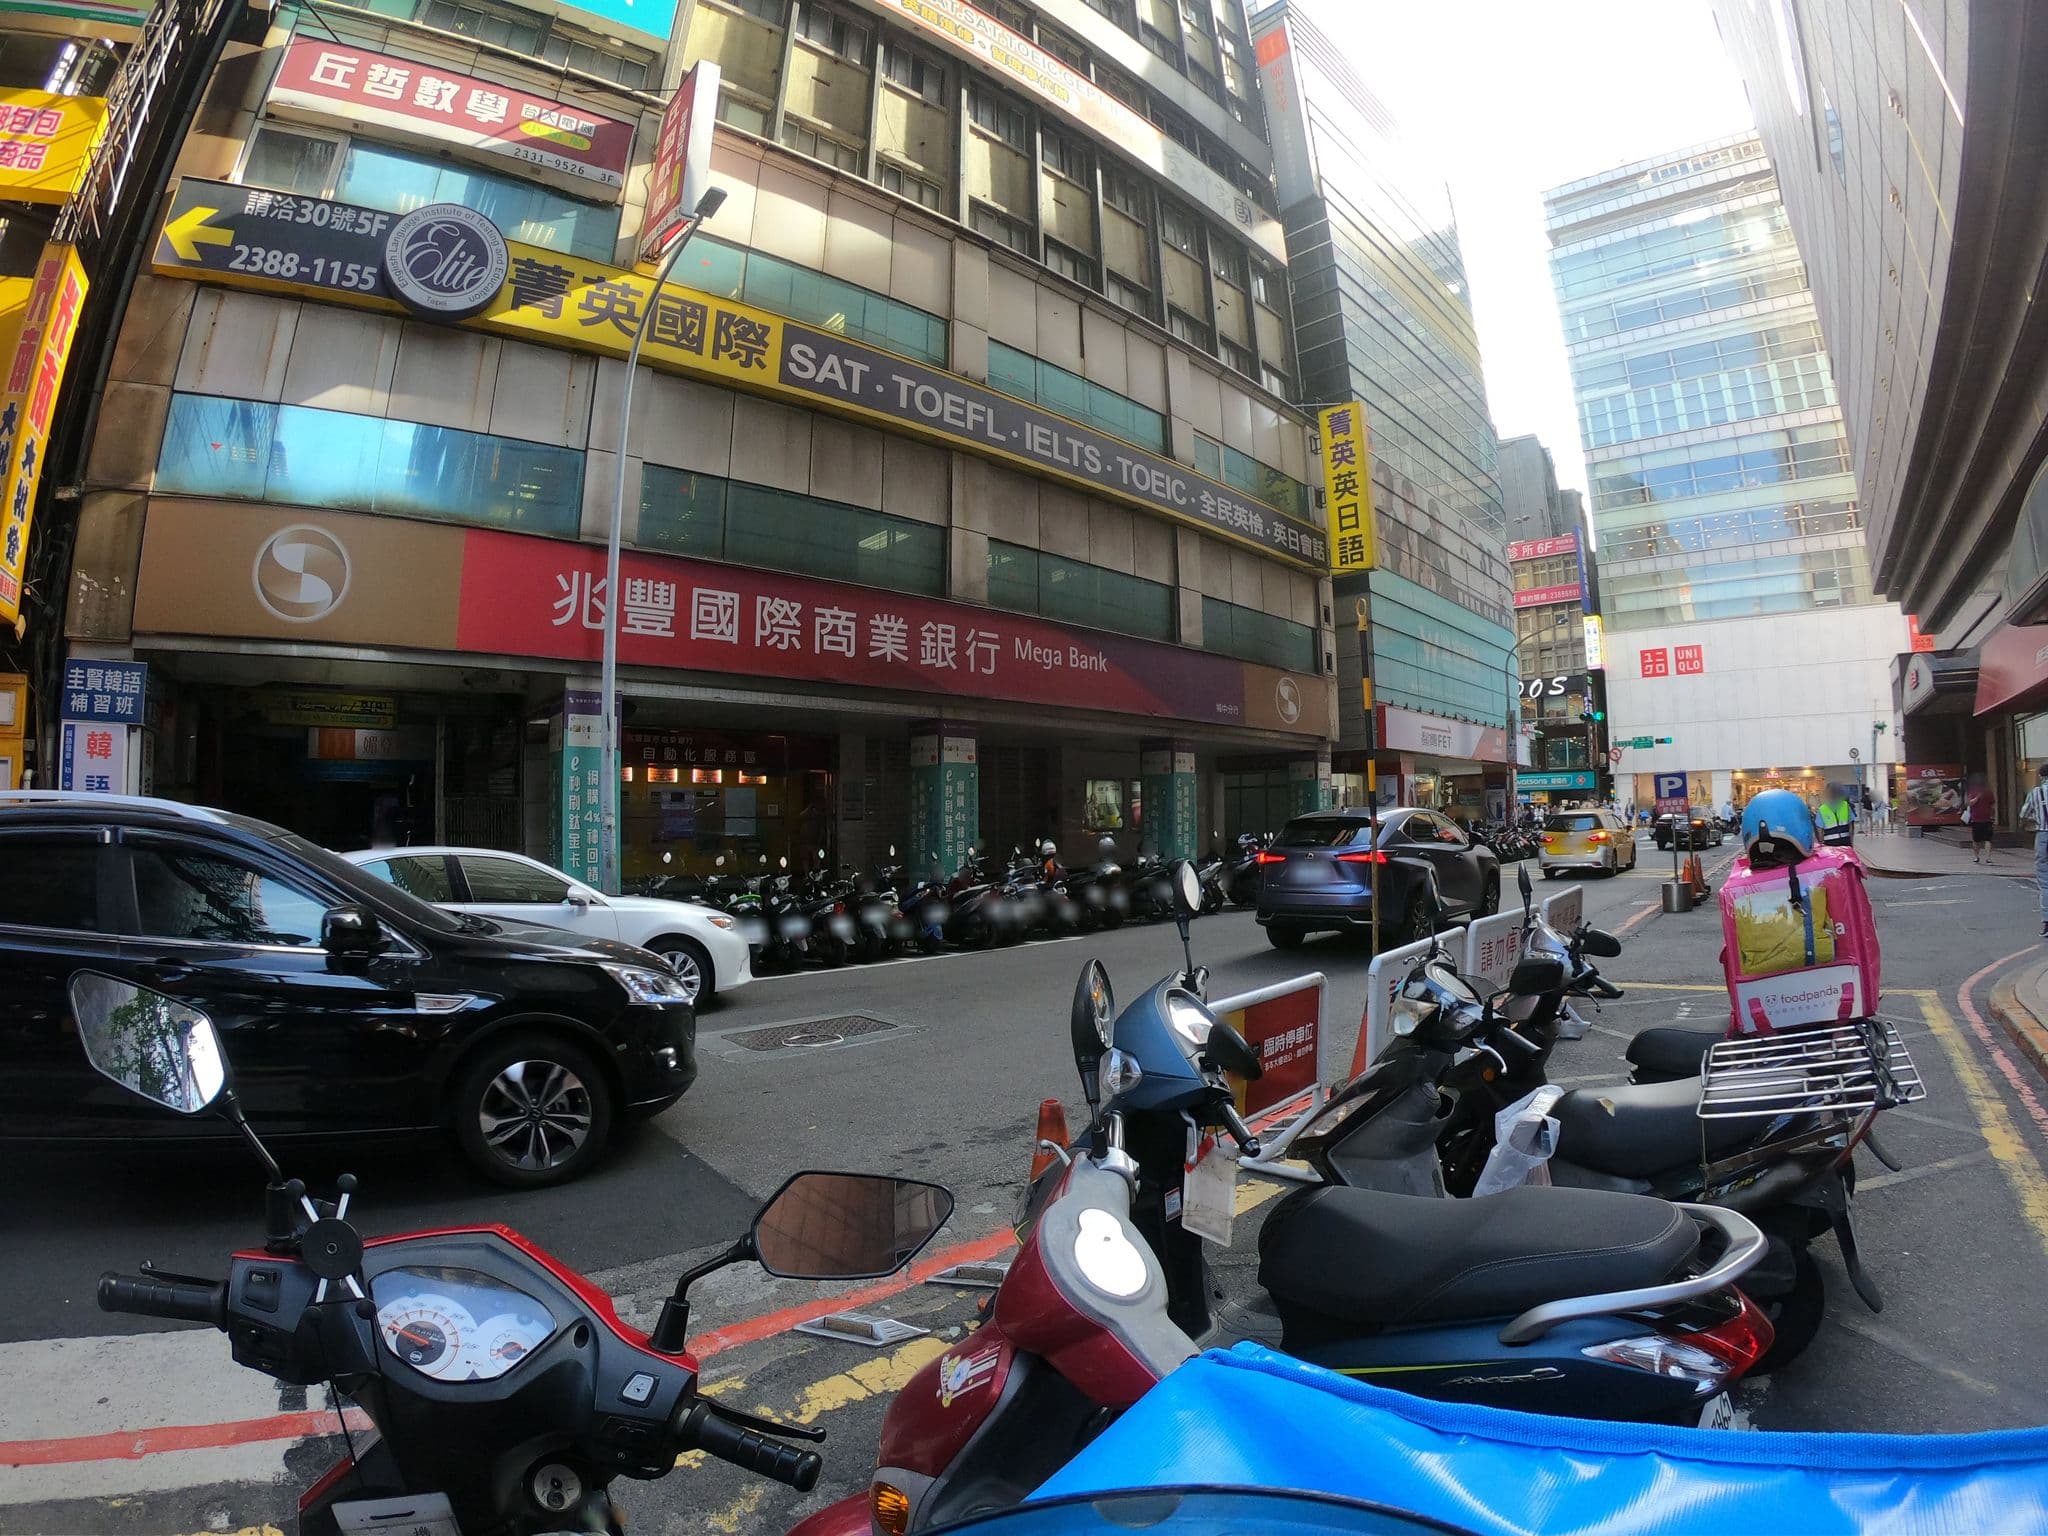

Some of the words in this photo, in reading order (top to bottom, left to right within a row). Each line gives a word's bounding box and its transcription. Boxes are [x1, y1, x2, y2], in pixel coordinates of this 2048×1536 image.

[309, 52, 510, 124] 丘哲數學
[514, 147, 585, 175] 2331-9526
[600, 170, 615, 183] 3F
[243, 190, 390, 238] 請洽30號5F
[421, 207, 462, 218] Institute
[465, 212, 475, 221] of
[390, 214, 421, 252] Language
[476, 218, 500, 247] Testing
[228, 244, 378, 291] 2388-1155
[389, 253, 409, 289] English
[404, 221, 487, 292] Elite
[496, 247, 504, 266] and
[469, 265, 504, 302] Education
[508, 257, 771, 371] 菁英國際
[787, 344, 871, 395] SAT
[891, 374, 1006, 444] TOEFL
[1025, 421, 1103, 474] IELTS
[1116, 455, 1188, 506] TOEIC
[1200, 489, 1264, 538] 全民英檢
[1272, 520, 1326, 562] 英日會話
[1326, 409, 1364, 567] 菁英英日語
[1537, 541, 1553, 554] 6F
[551, 570, 1001, 676] 兆豐國際商業銀行
[1014, 637, 1062, 671] Mega
[1069, 645, 1108, 673] Bank
[1643, 651, 1665, 663] ユニ
[1643, 664, 1665, 675] クロ
[1676, 648, 1698, 660] UNI
[1678, 660, 1701, 673] QLO
[67, 666, 142, 695] 圭賢韓語
[70, 692, 135, 715] 補習班
[85, 731, 113, 793] 韓語
[1659, 776, 1683, 798] P
[1781, 984, 1839, 1005] foodpanda
[1264, 1022, 1314, 1058] 臨時停車位
